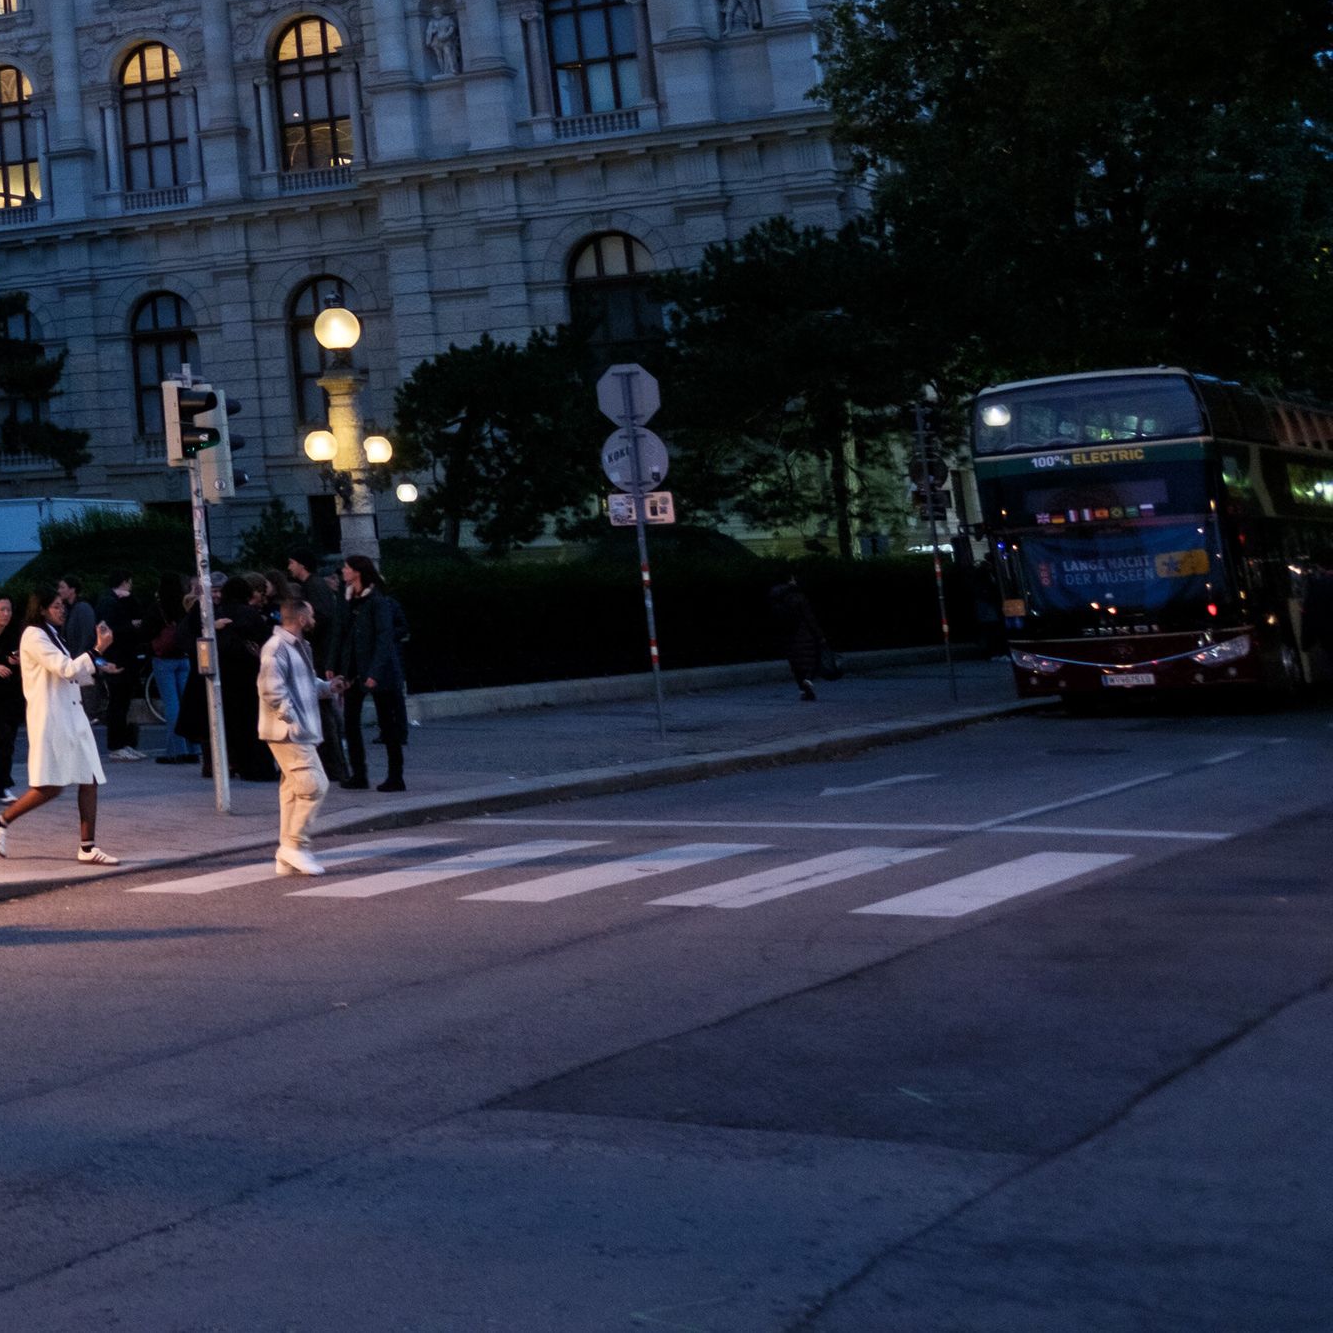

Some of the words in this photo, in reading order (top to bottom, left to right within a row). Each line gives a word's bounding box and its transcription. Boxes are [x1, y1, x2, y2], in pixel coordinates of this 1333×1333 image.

[1031, 454, 1070, 469] 100%
[1071, 448, 1145, 466] ELECTRIC
[1063, 558, 1106, 573] LANGE
[1107, 555, 1151, 570] NACHT
[1065, 571, 1094, 586] DER
[1096, 567, 1158, 584] MUSEEN
